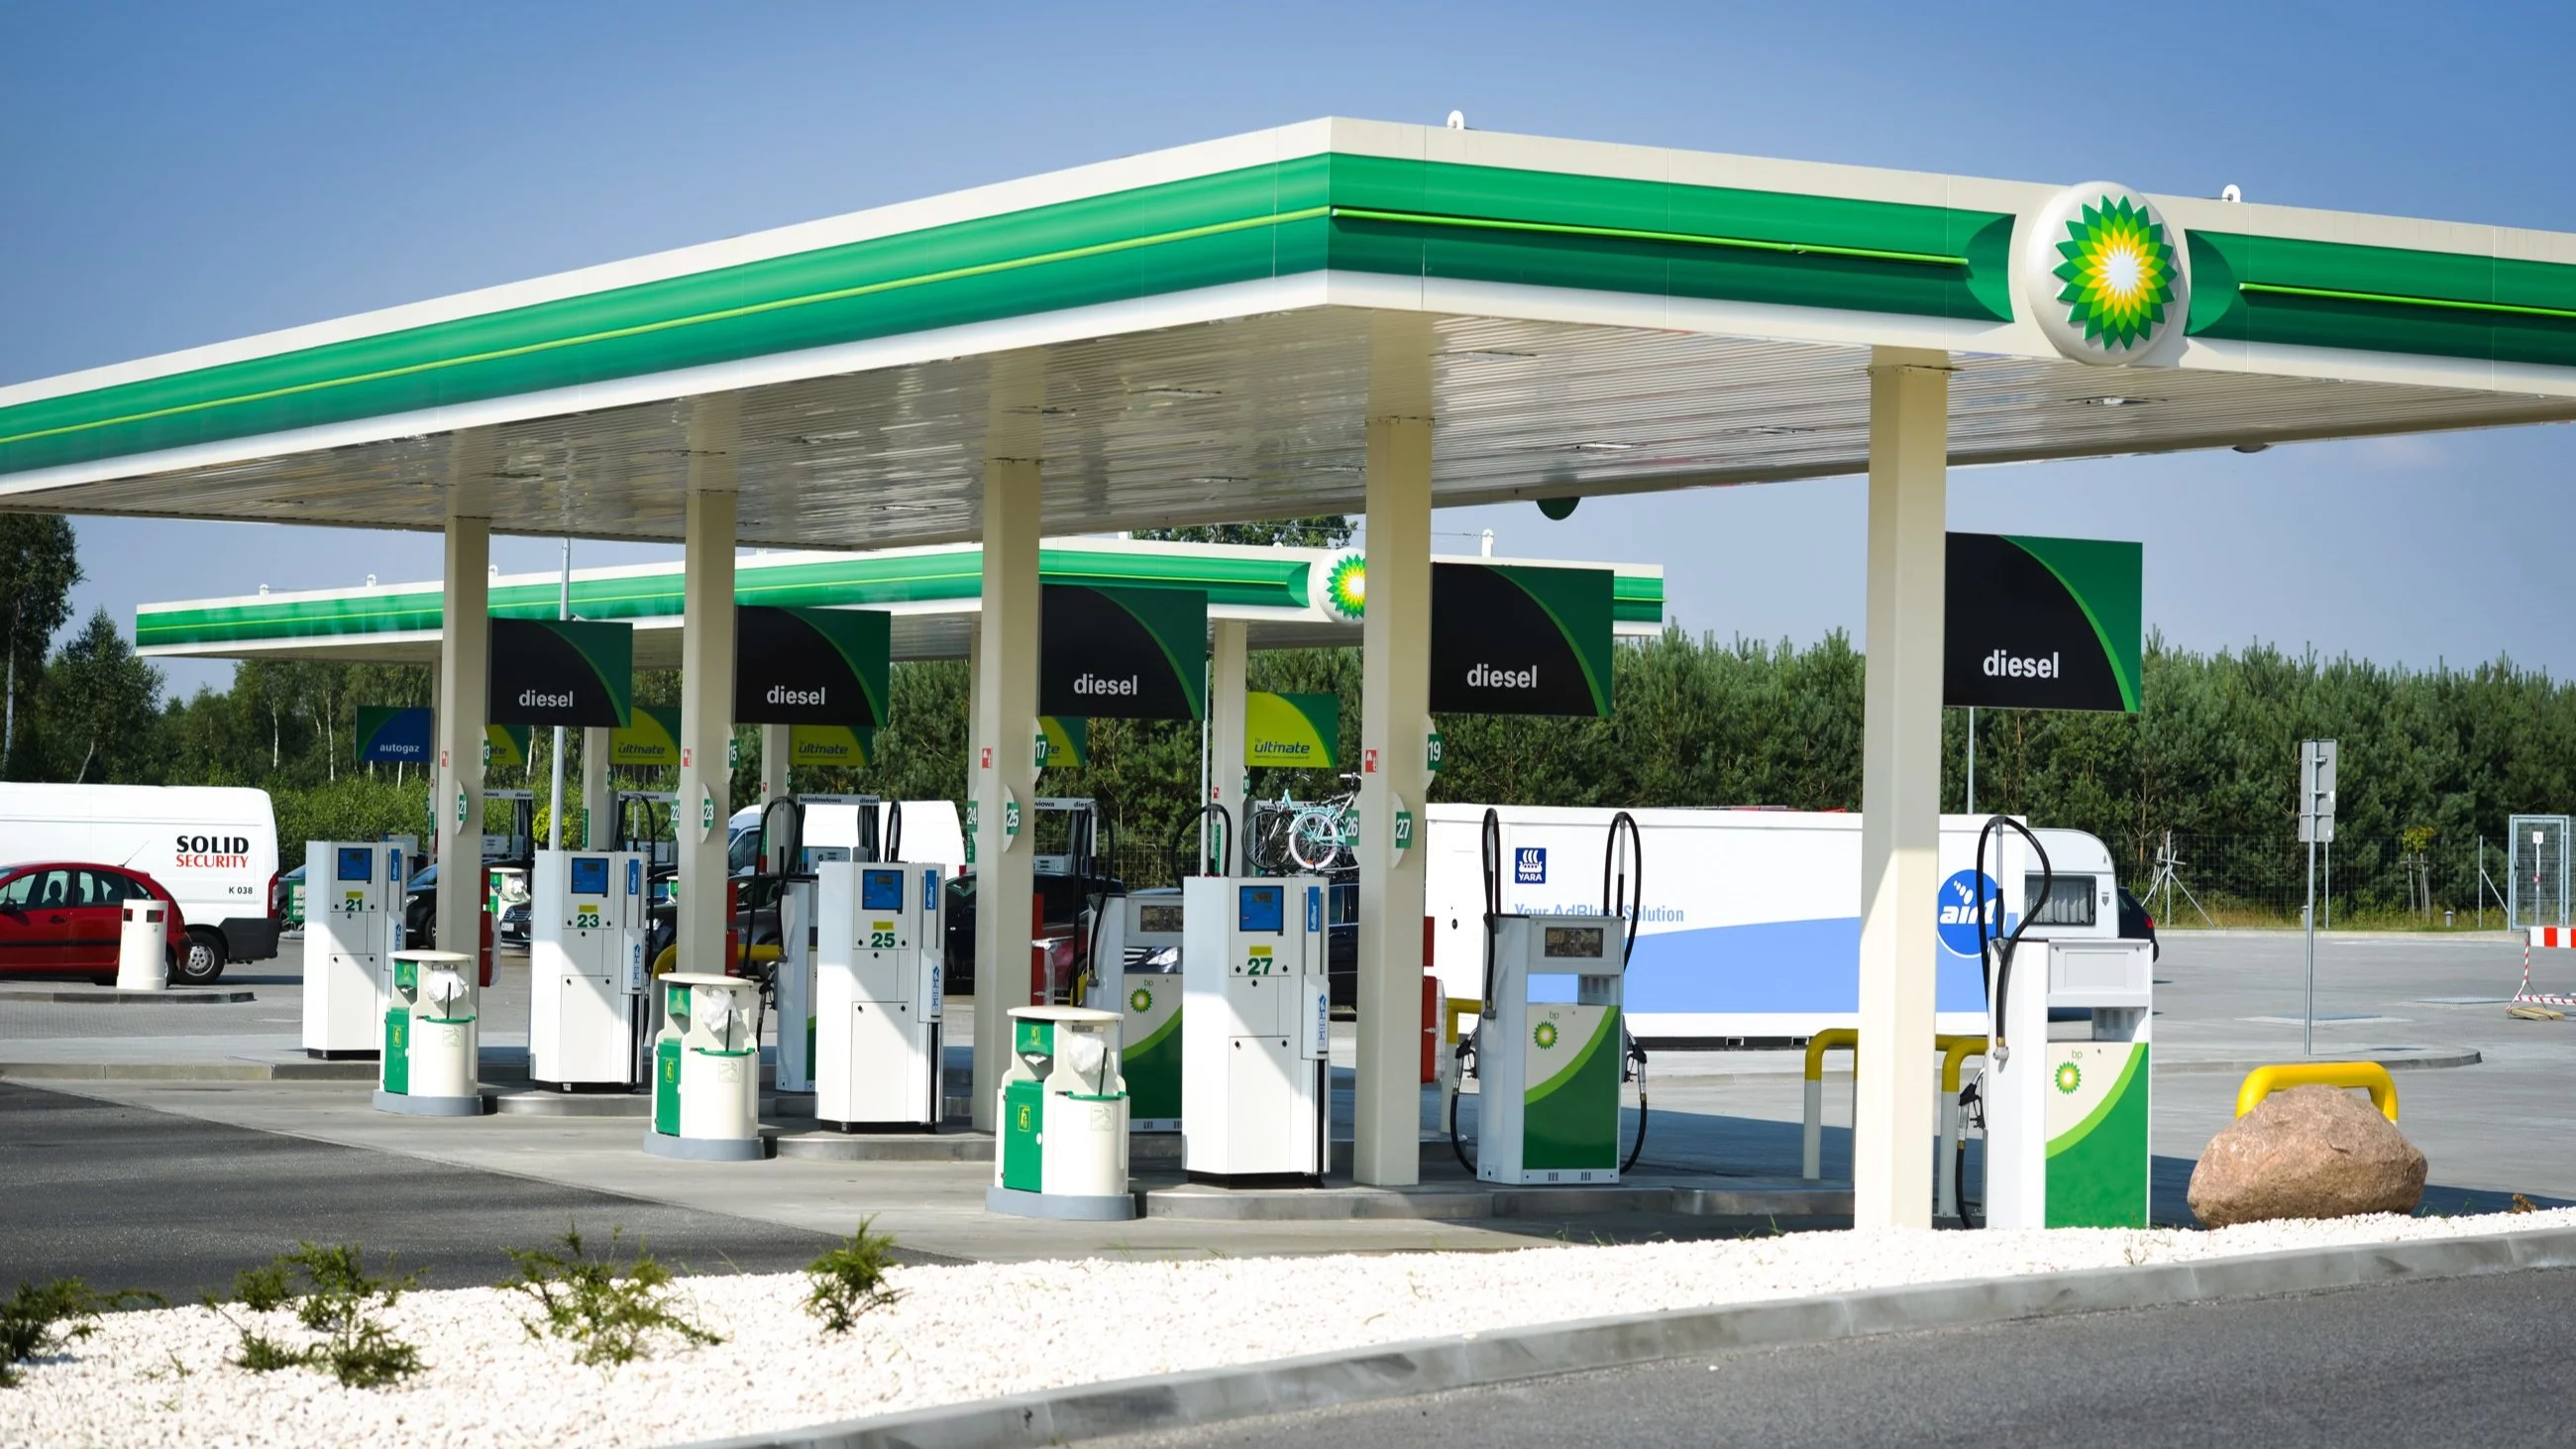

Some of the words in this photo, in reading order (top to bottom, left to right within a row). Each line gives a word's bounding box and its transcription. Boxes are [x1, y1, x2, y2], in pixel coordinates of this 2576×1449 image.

[1983, 649, 2060, 679] diesel
[1466, 663, 1538, 689] diesel
[1073, 674, 1138, 696] diesel
[518, 689, 574, 708] diesel
[766, 685, 826, 706] diesel
[379, 743, 420, 754] autogaz
[483, 745, 490, 760] 13
[617, 743, 666, 754] ultimate
[729, 745, 737, 761] 15
[798, 743, 849, 754] ultimate
[1035, 741, 1046, 759] 17
[1253, 741, 1311, 754] ultimate
[1428, 740, 1442, 762] 19
[459, 800, 467, 815] 21
[671, 805, 680, 821] 22
[703, 805, 714, 821] 23
[967, 807, 978, 825] 24
[1007, 810, 1020, 828] 25
[1344, 816, 1358, 837] 26
[1395, 819, 1411, 839] 27
[176, 835, 250, 854] SOLID
[175, 854, 249, 868] SECURITY
[817, 853, 824, 862] 6
[1518, 873, 1543, 882] YARA
[228, 886, 235, 895] K
[237, 886, 254, 895] 038
[345, 898, 363, 912] 21
[1623, 904, 1684, 922] Slution
[577, 914, 600, 928] 23
[871, 933, 896, 947] 25
[1247, 957, 1273, 975] 27
[1143, 978, 1154, 987] bp
[1549, 1010, 1559, 1021] bp
[2071, 1049, 2084, 1060] bp
